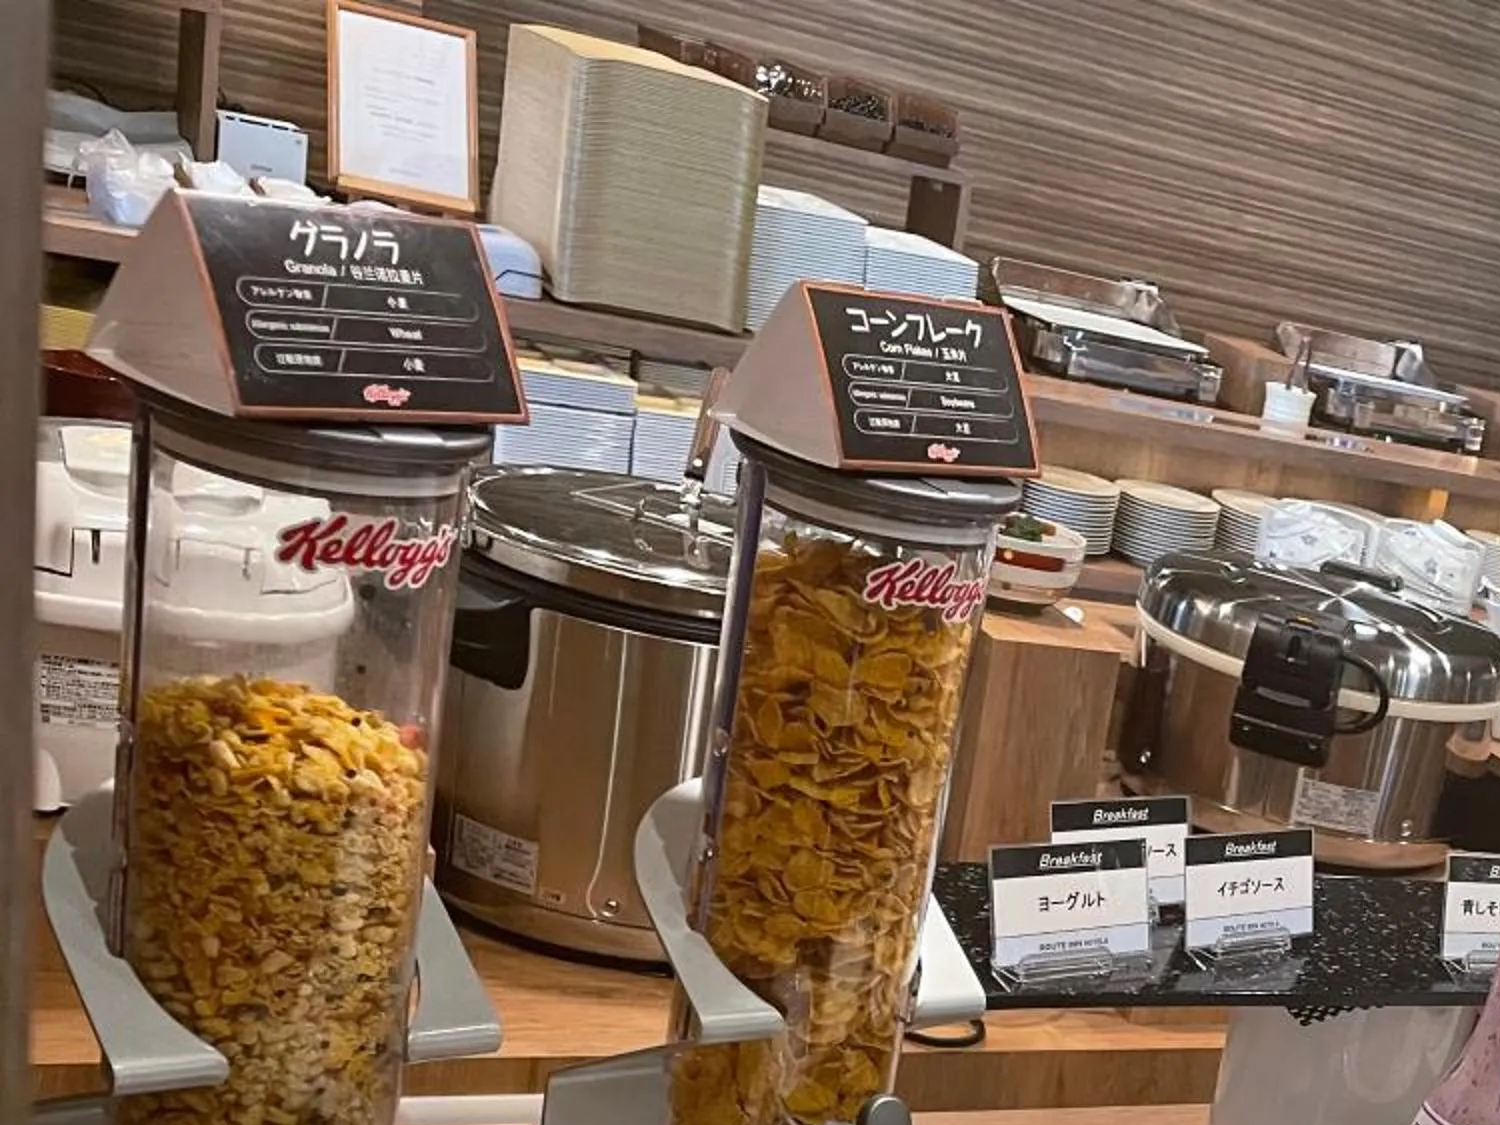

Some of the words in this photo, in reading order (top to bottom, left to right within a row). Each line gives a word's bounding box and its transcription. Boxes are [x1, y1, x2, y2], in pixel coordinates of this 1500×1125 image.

[289, 219, 400, 265] グラノラ
[284, 259, 337, 277] Granola
[845, 307, 982, 349] コーンフレーク
[277, 514, 457, 588] Kellogg's
[1092, 807, 1150, 825] Breakfast
[1224, 839, 1277, 857] Breakfast
[1039, 851, 1103, 869] Breakfast
[1217, 877, 1285, 896] イチゴソース
[1038, 891, 1105, 912] ヨーグルト
